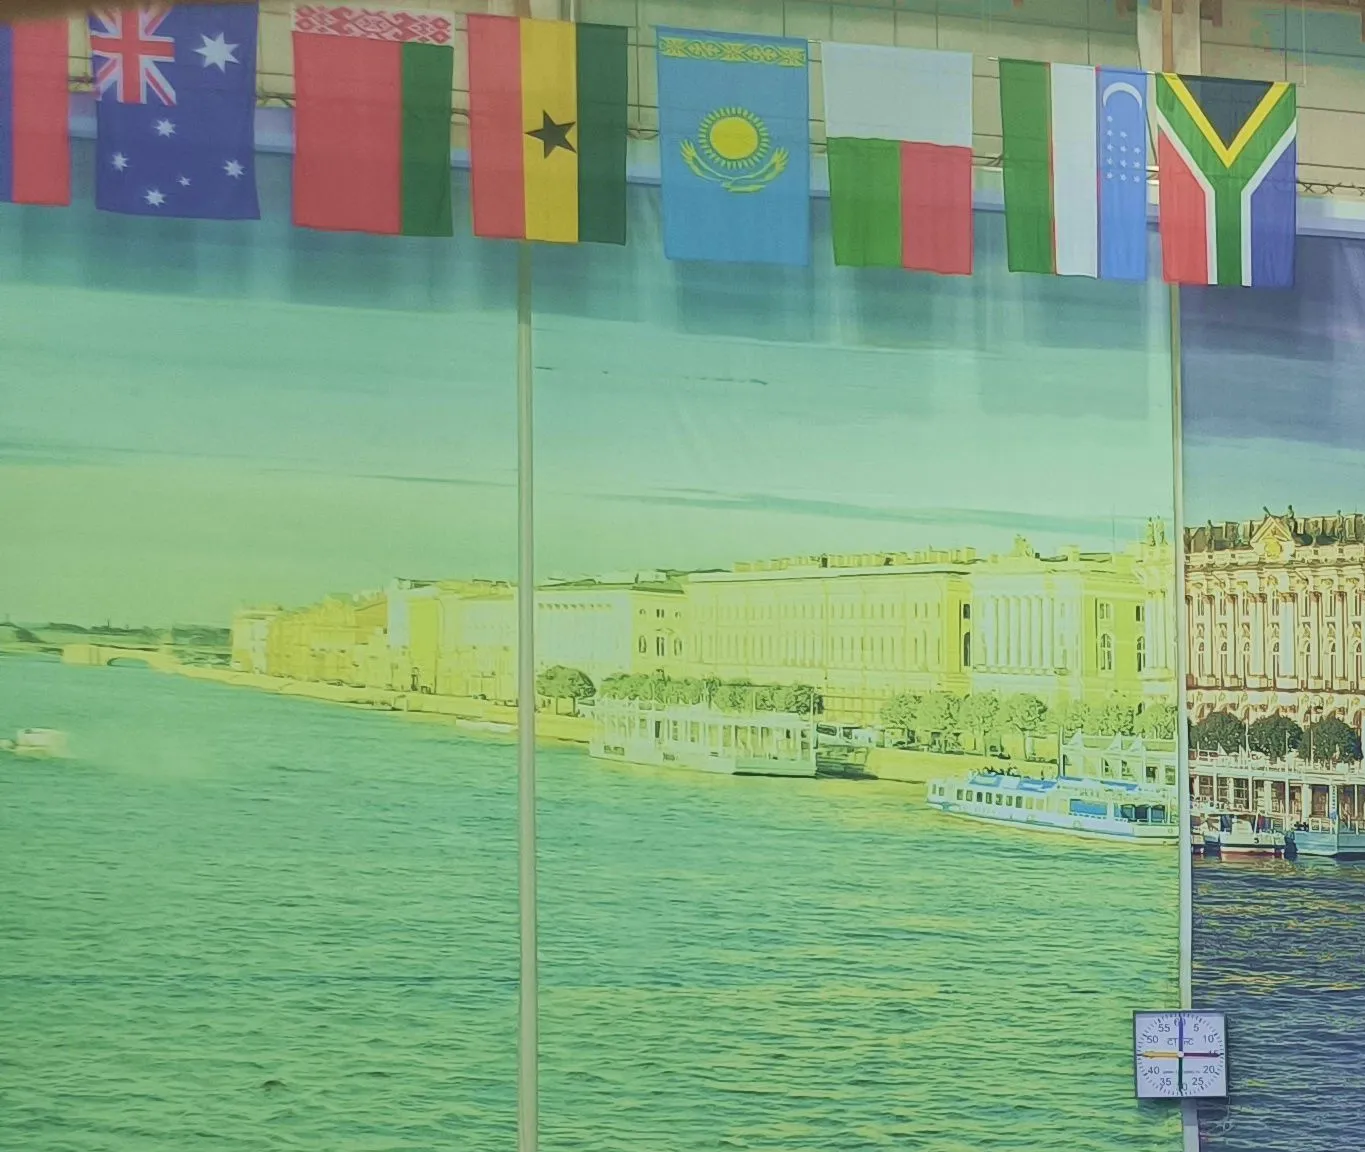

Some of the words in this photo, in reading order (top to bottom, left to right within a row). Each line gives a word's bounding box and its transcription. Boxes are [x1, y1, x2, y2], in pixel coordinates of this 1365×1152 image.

[1158, 1023, 1171, 1032] 55
[1193, 1023, 1200, 1032] 5
[1147, 1035, 1159, 1044] 50
[1203, 1034, 1215, 1044] 10
[1148, 1065, 1160, 1075] 40
[1203, 1065, 1215, 1074] 20
[1192, 1077, 1204, 1086] 25
